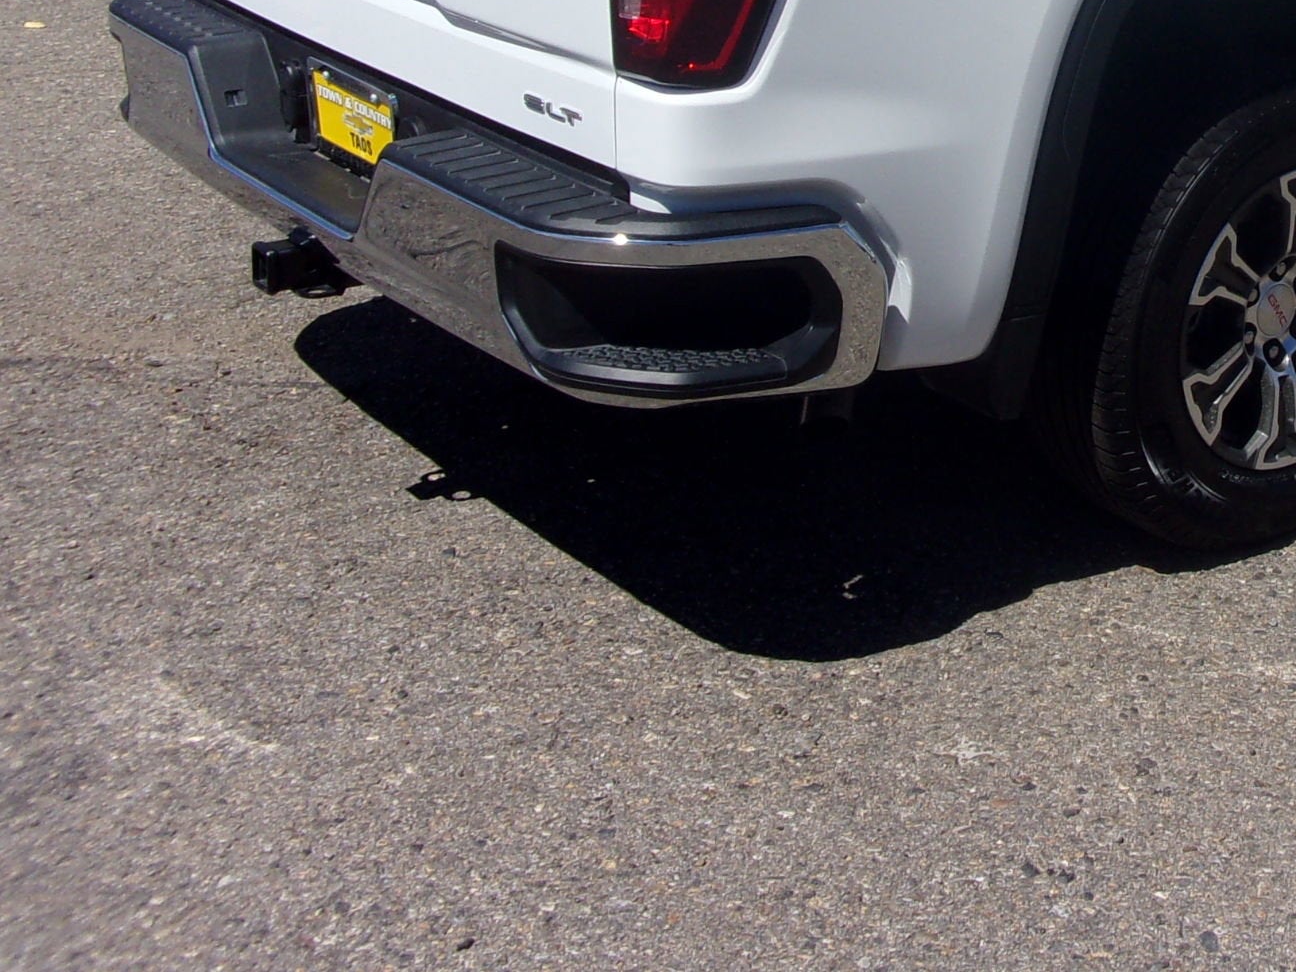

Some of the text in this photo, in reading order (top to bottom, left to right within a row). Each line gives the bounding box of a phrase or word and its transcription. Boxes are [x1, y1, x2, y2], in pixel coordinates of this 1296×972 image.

[317, 85, 392, 130] TOWN & COUNTRY
[523, 93, 582, 127] SLT
[349, 132, 373, 156] TAOS
[1267, 293, 1288, 328] GMC
